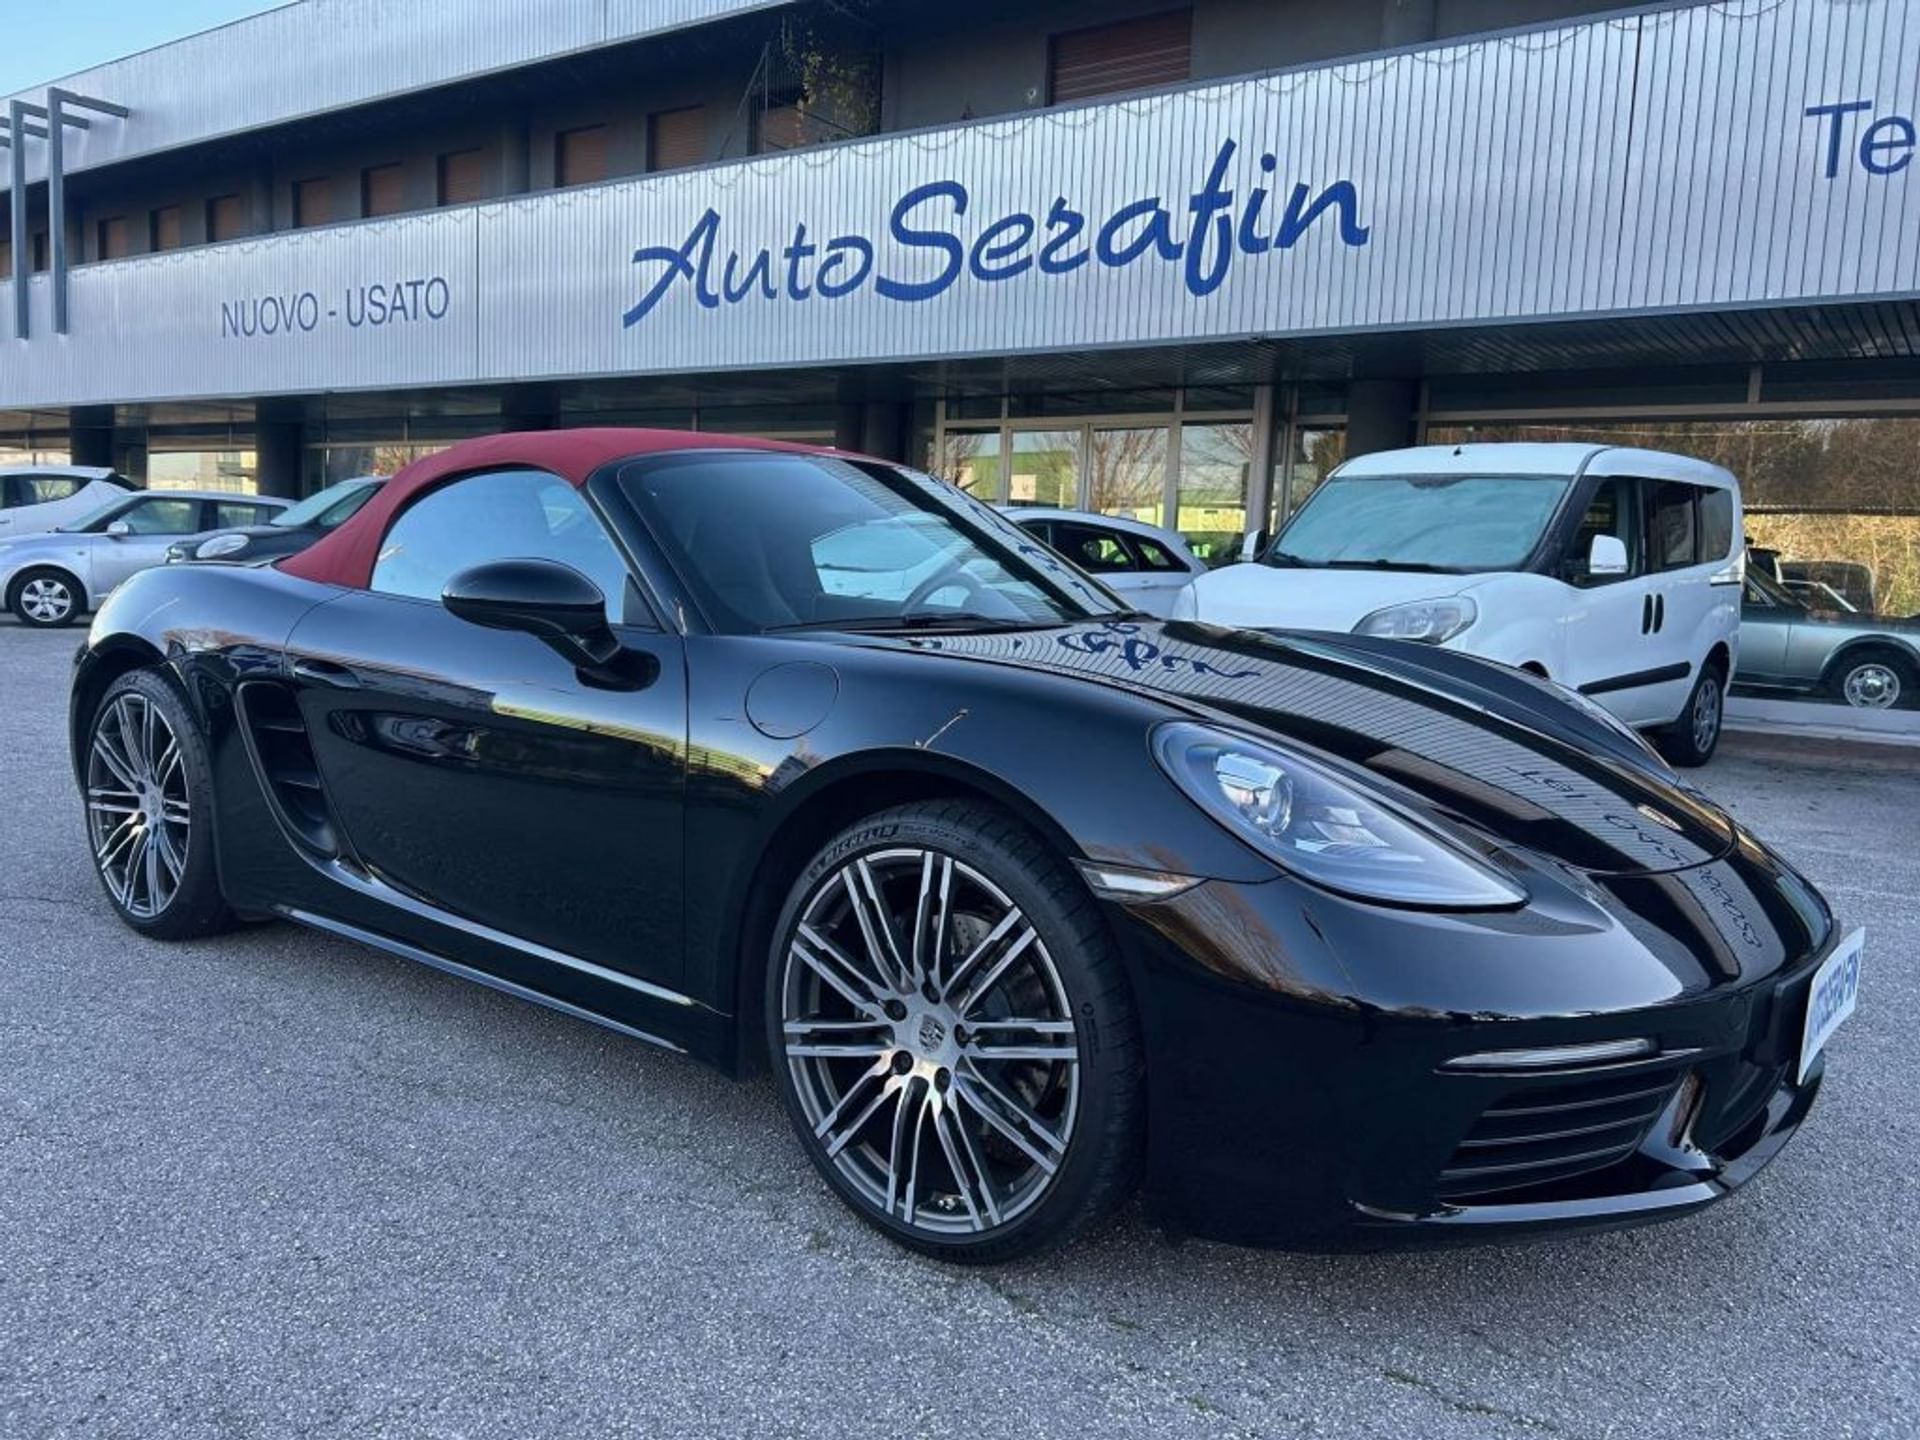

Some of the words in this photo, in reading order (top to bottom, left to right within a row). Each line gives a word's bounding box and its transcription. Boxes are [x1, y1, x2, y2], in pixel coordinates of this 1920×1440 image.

[1804, 100, 1916, 179] Te
[623, 137, 1370, 329] AutoSerafin
[221, 292, 318, 338] NUOVO
[346, 276, 449, 327] USATO
